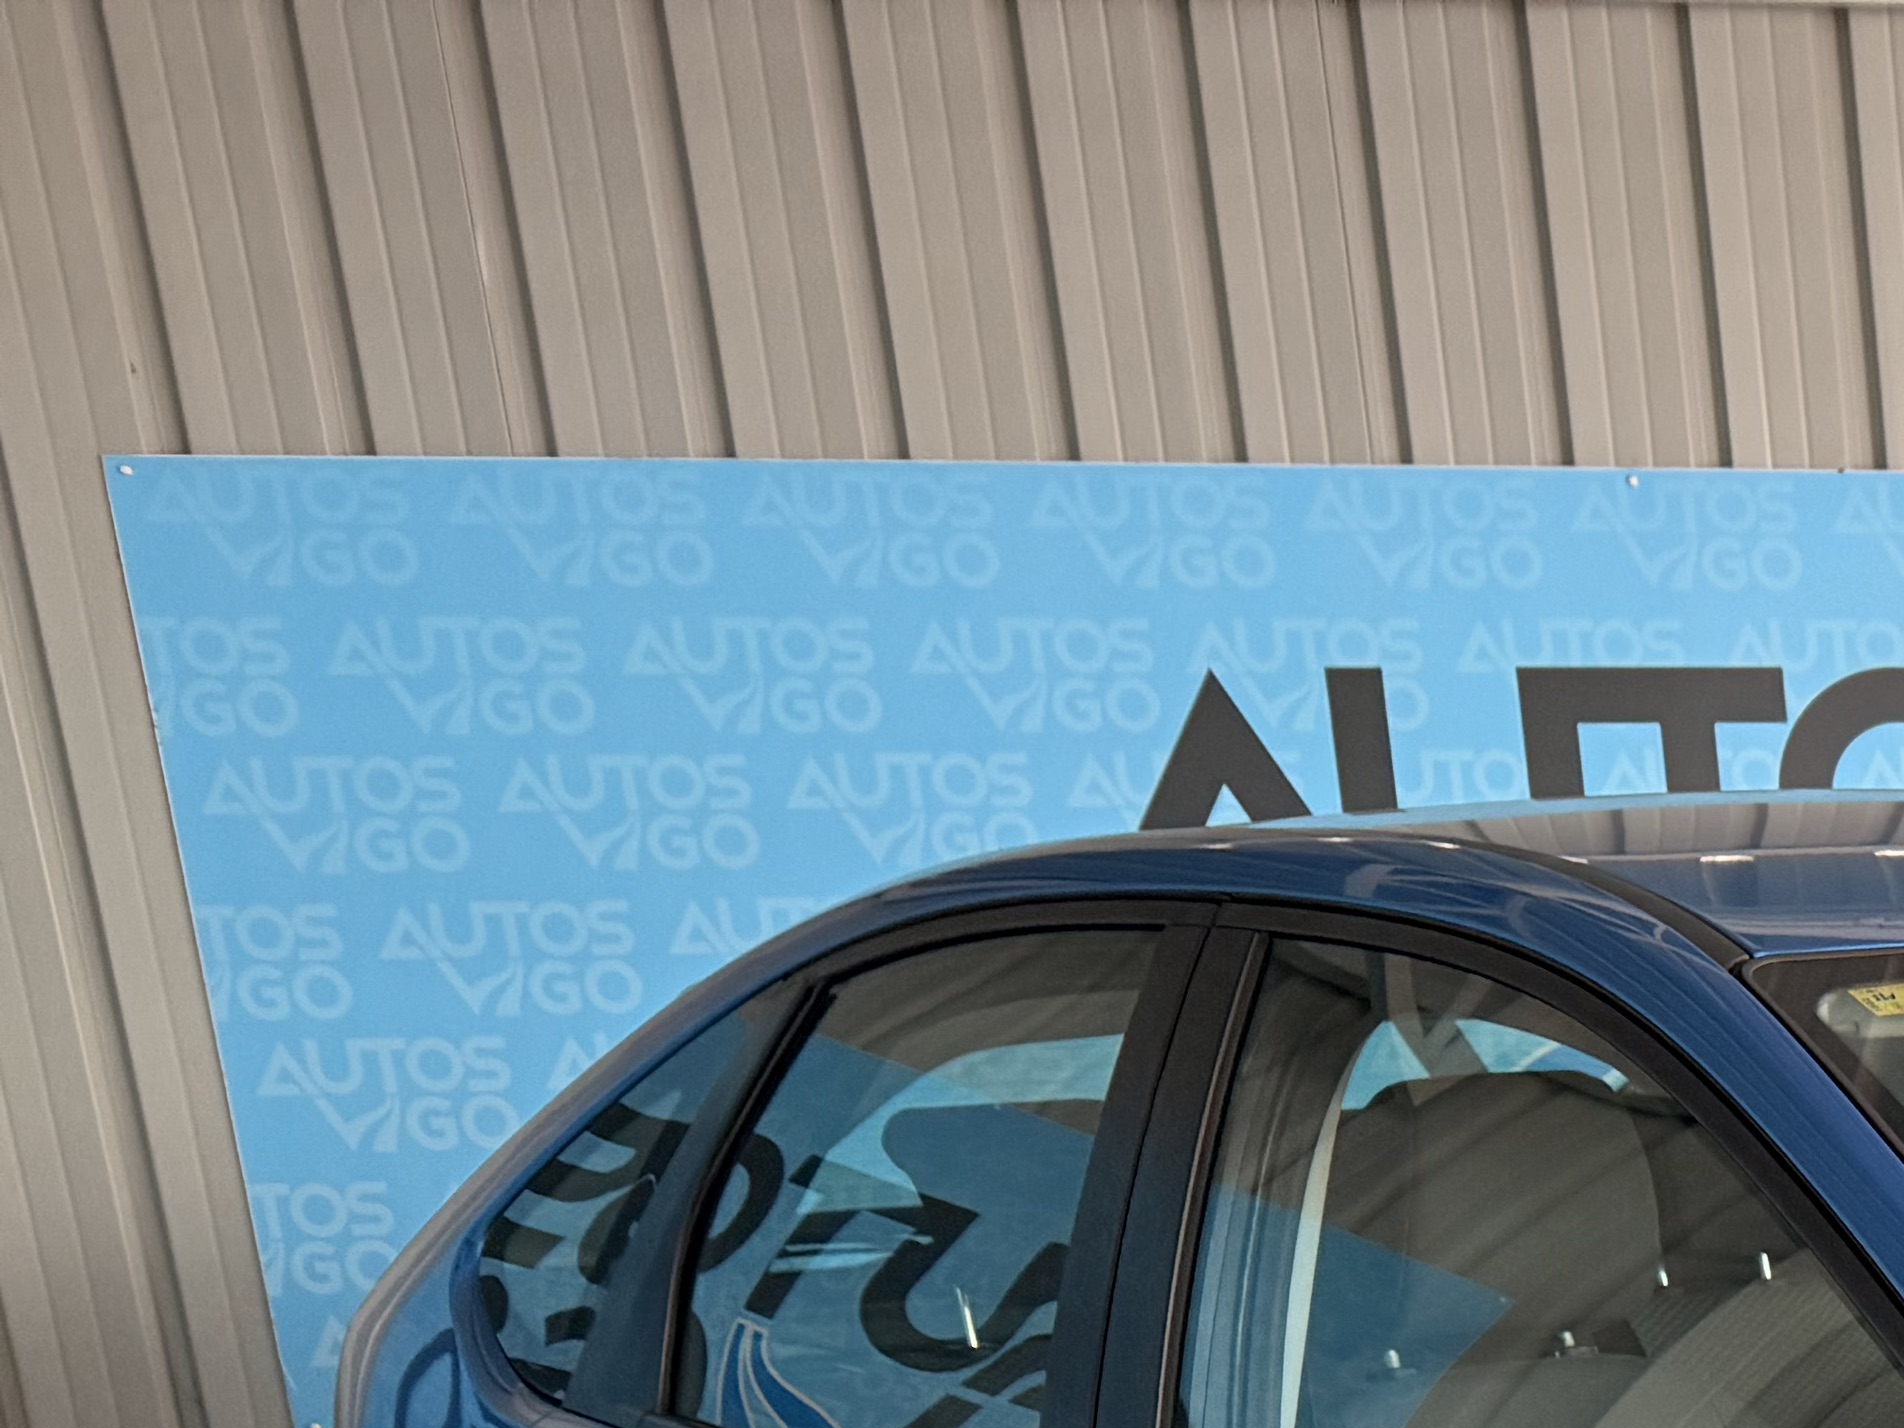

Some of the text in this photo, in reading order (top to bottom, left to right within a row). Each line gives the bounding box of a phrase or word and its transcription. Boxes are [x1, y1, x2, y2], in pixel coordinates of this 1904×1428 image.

[144, 471, 410, 525] AUTOS
[449, 471, 706, 525] AUTOS
[742, 472, 994, 528] AUTOS
[1028, 474, 1270, 529] AUTOS
[1303, 475, 1536, 531] AUTOS
[1570, 479, 1797, 533] AUTOS
[138, 616, 290, 676] TOS
[327, 616, 586, 676] AUTOS
[622, 616, 875, 676] AUTOS
[909, 617, 1153, 675] AUTOS
[1187, 617, 1423, 676] AUTOS
[1456, 620, 1684, 673] AUTOS
[203, 755, 462, 814] AUTOS
[497, 754, 754, 814] AUTOS
[787, 752, 1033, 809] AUTOS
[197, 904, 343, 961] TOS
[377, 901, 635, 960] AUTOS
[255, 1037, 511, 1097] AUTOS
[250, 1181, 394, 1238] TOS
